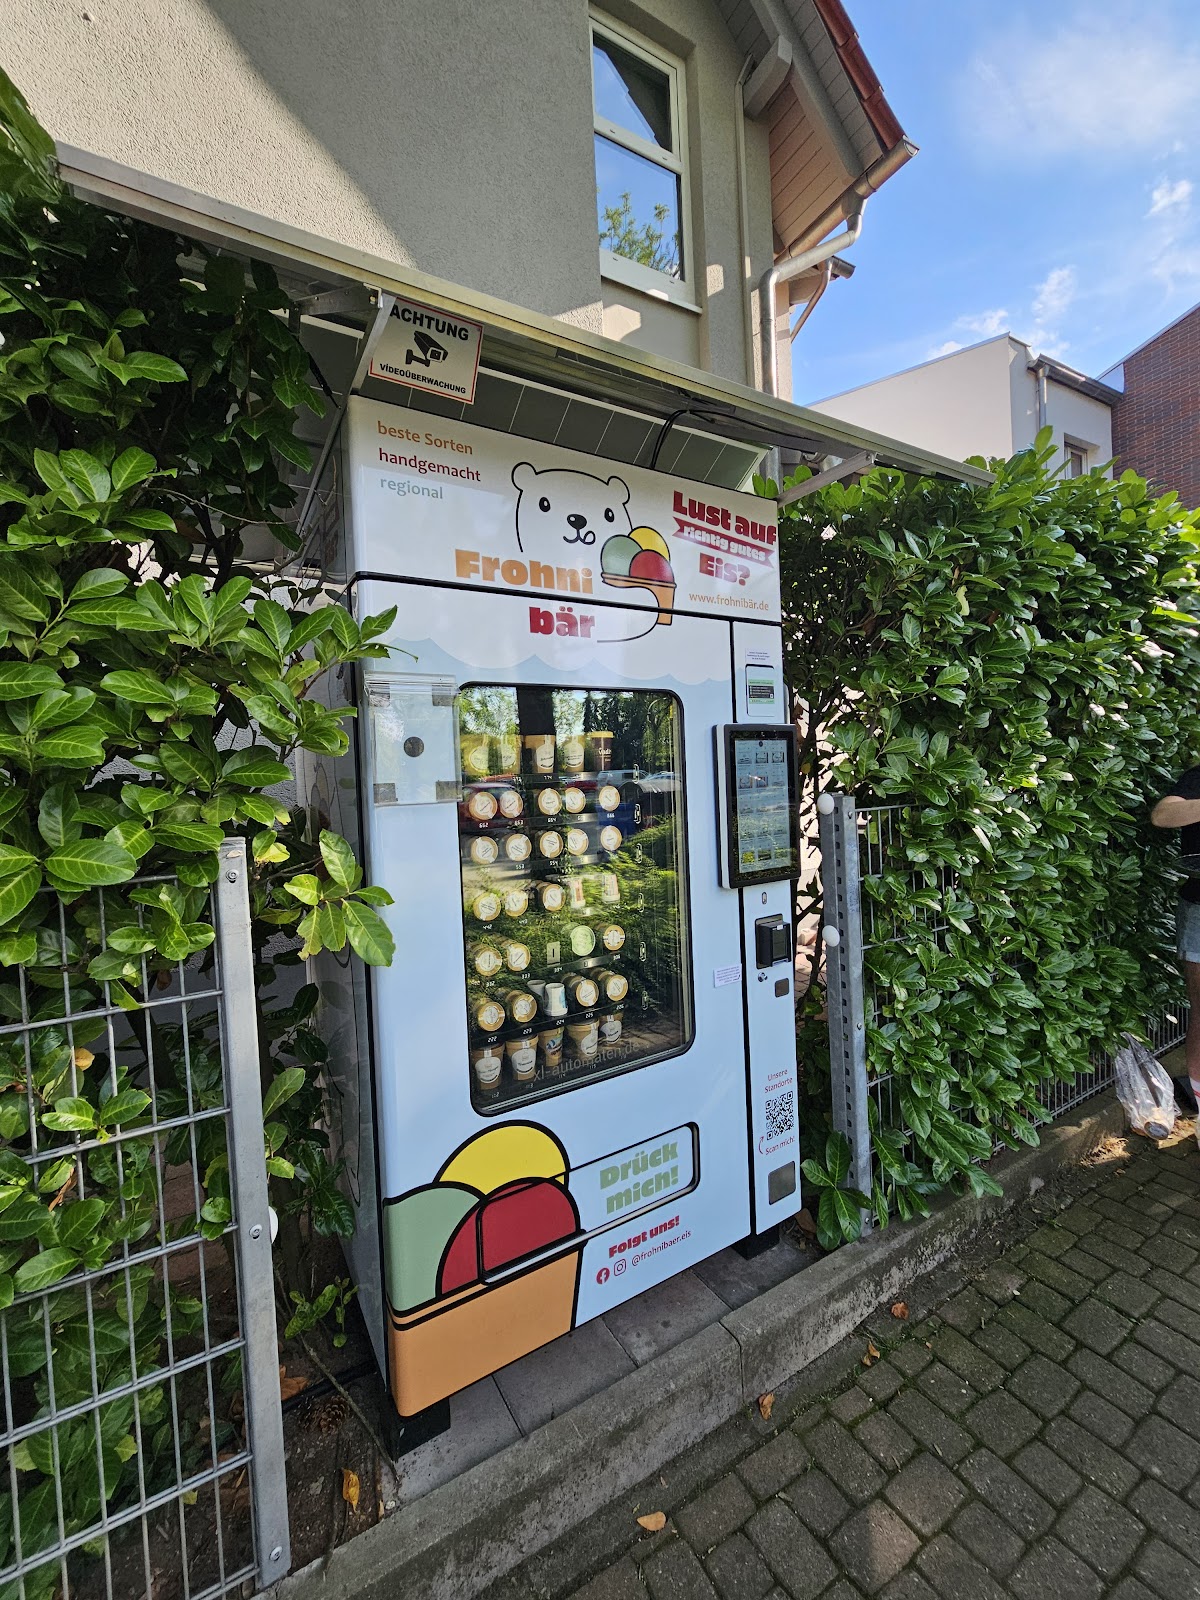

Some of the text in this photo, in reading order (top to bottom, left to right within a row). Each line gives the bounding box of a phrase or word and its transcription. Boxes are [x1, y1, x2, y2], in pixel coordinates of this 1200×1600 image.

[390, 304, 469, 341] ACHTUNG
[377, 420, 473, 455] beste Sorten
[378, 447, 481, 482] handgemacht
[380, 478, 443, 500] regional
[673, 489, 777, 546] Lust auf
[683, 525, 766, 562] richtig gutes
[455, 548, 593, 594] Frohni
[699, 552, 751, 587] Eis?
[688, 593, 769, 611] www.frohnibär.de
[529, 605, 596, 639] bär
[534, 1041, 640, 1082] xl-automaten.de
[767, 1069, 788, 1082] Unsere
[764, 1077, 793, 1093] Standorte
[600, 1141, 679, 1190] Drück
[765, 1143, 779, 1156] Scan
[606, 1164, 679, 1215] mich!
[608, 1214, 680, 1259] Folgt uns!
[631, 1229, 692, 1267] @frohnibaer.eis
